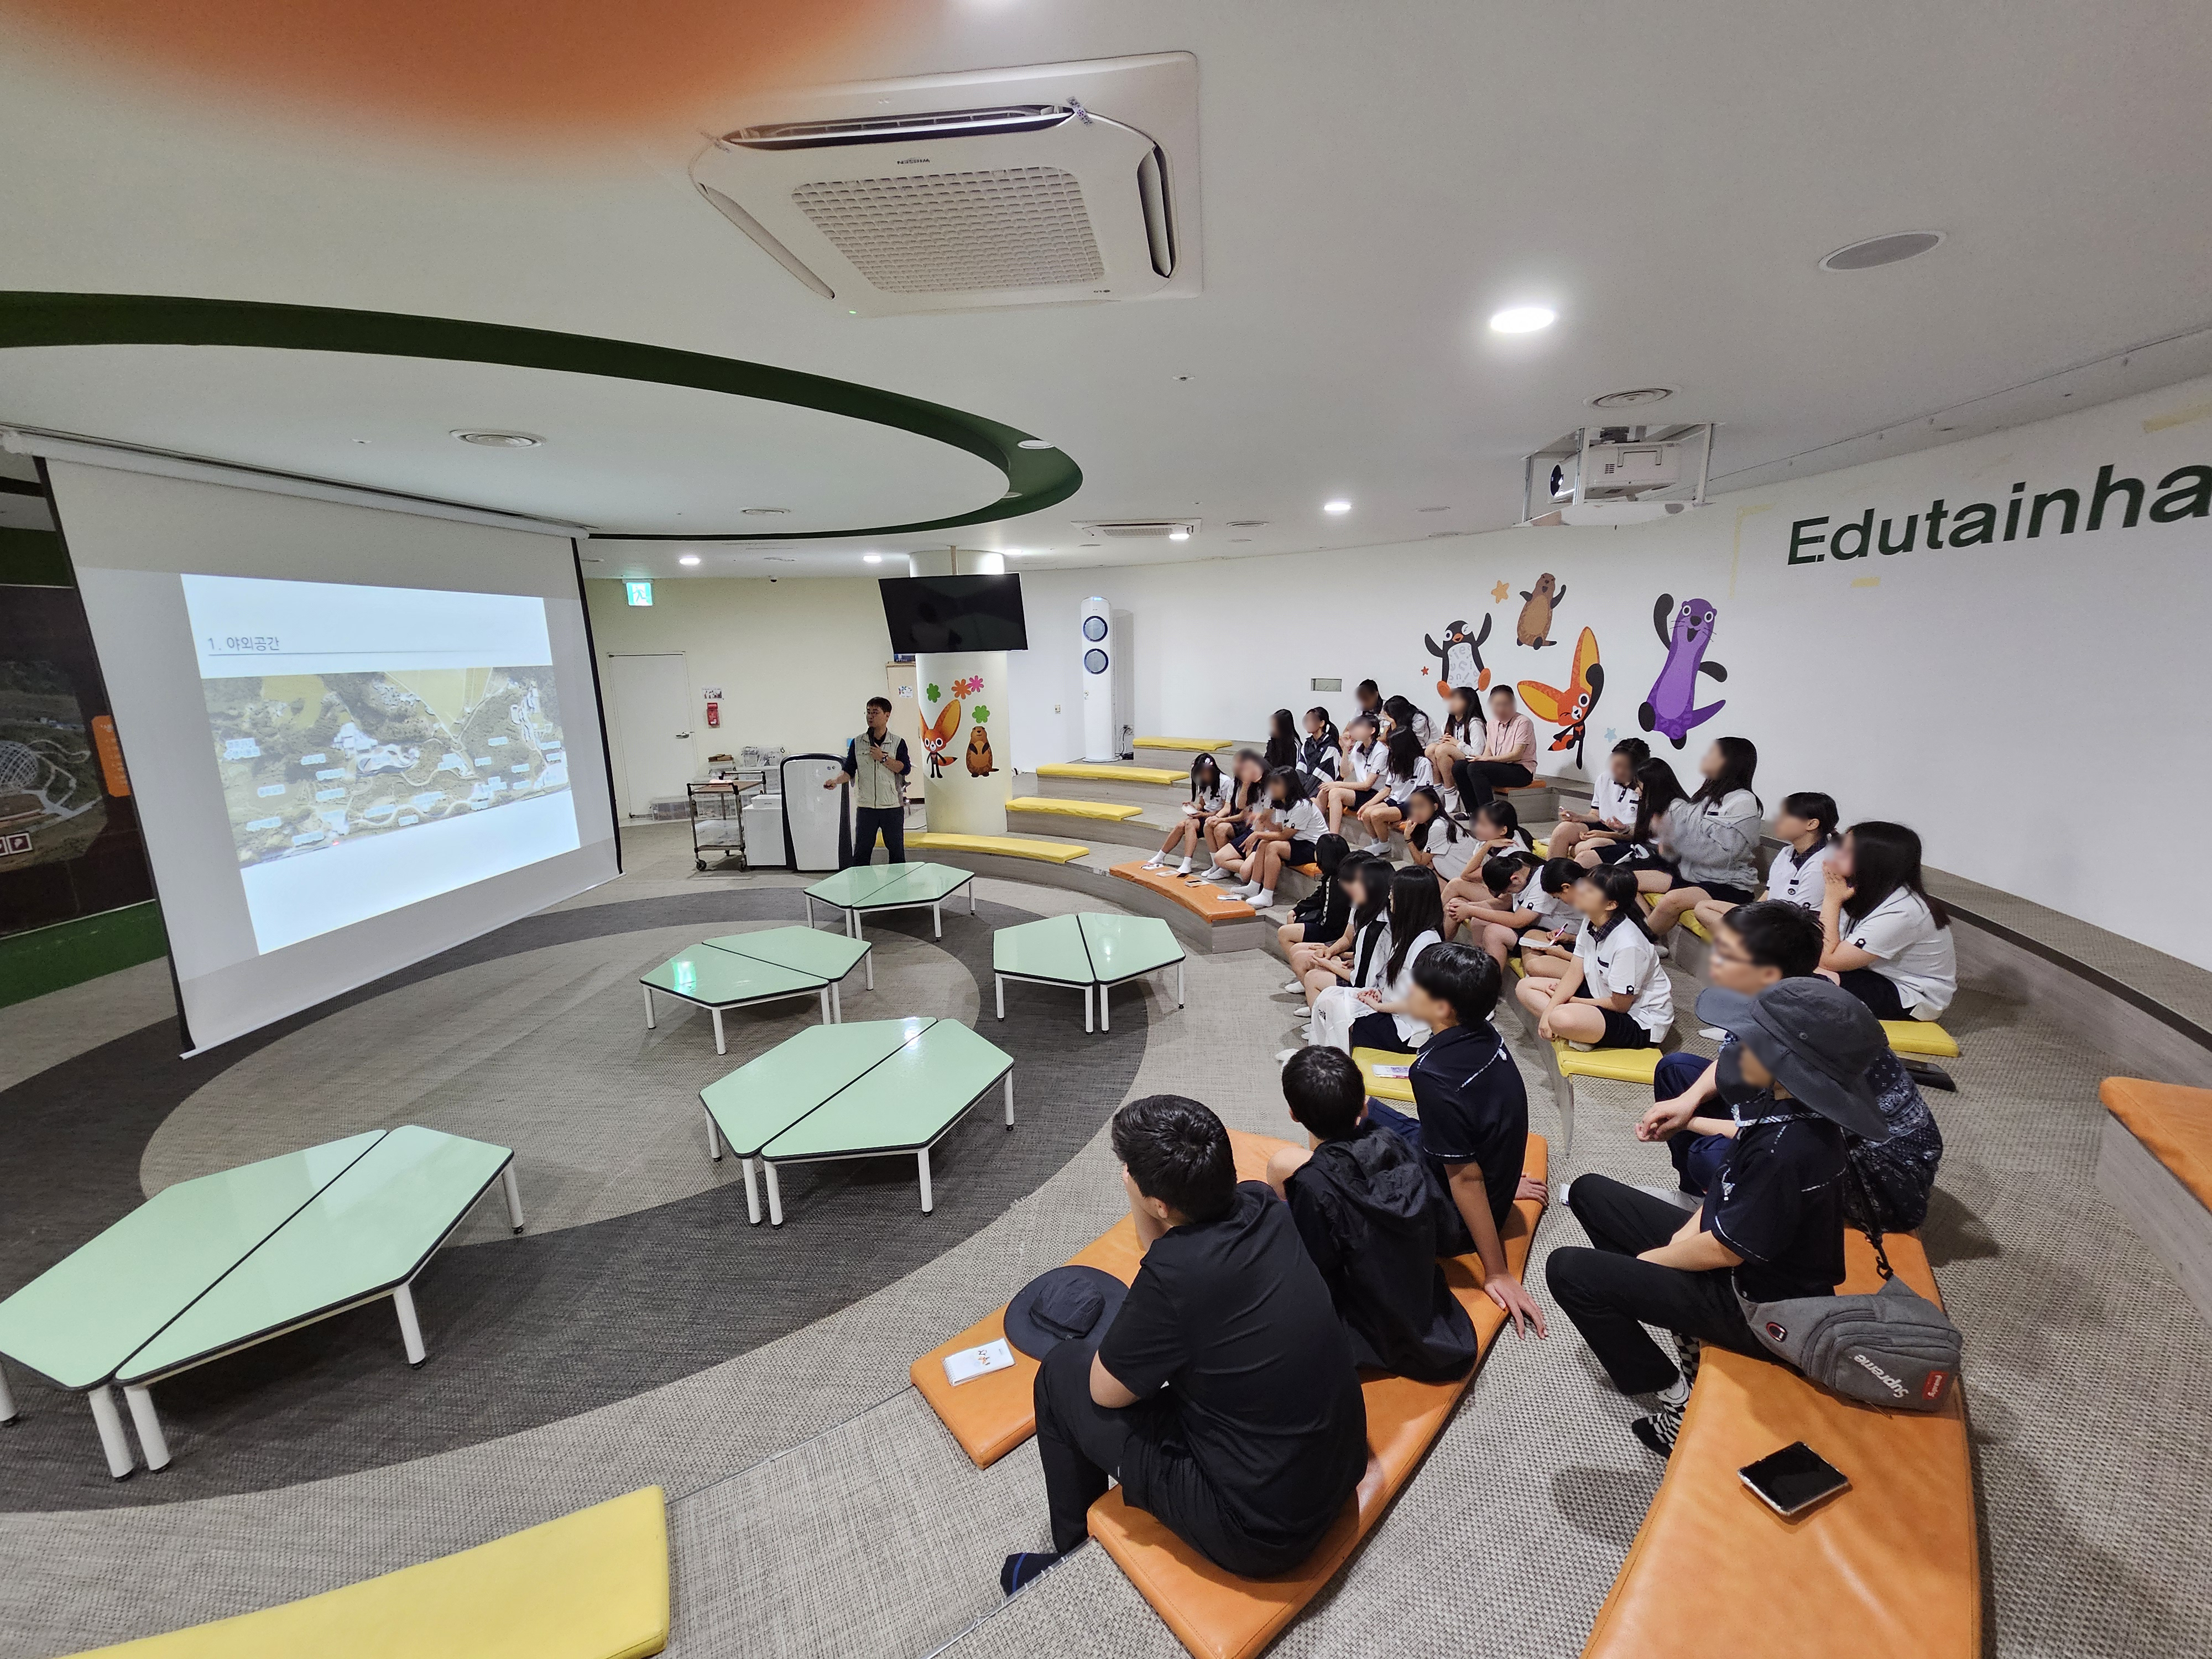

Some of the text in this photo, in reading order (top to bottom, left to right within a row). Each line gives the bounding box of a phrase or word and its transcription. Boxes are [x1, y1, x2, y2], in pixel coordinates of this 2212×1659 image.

[1787, 463, 2212, 565] Edutainha
[208, 636, 280, 651] 1. 야외공간
[1853, 1354, 1910, 1399] Supreme
